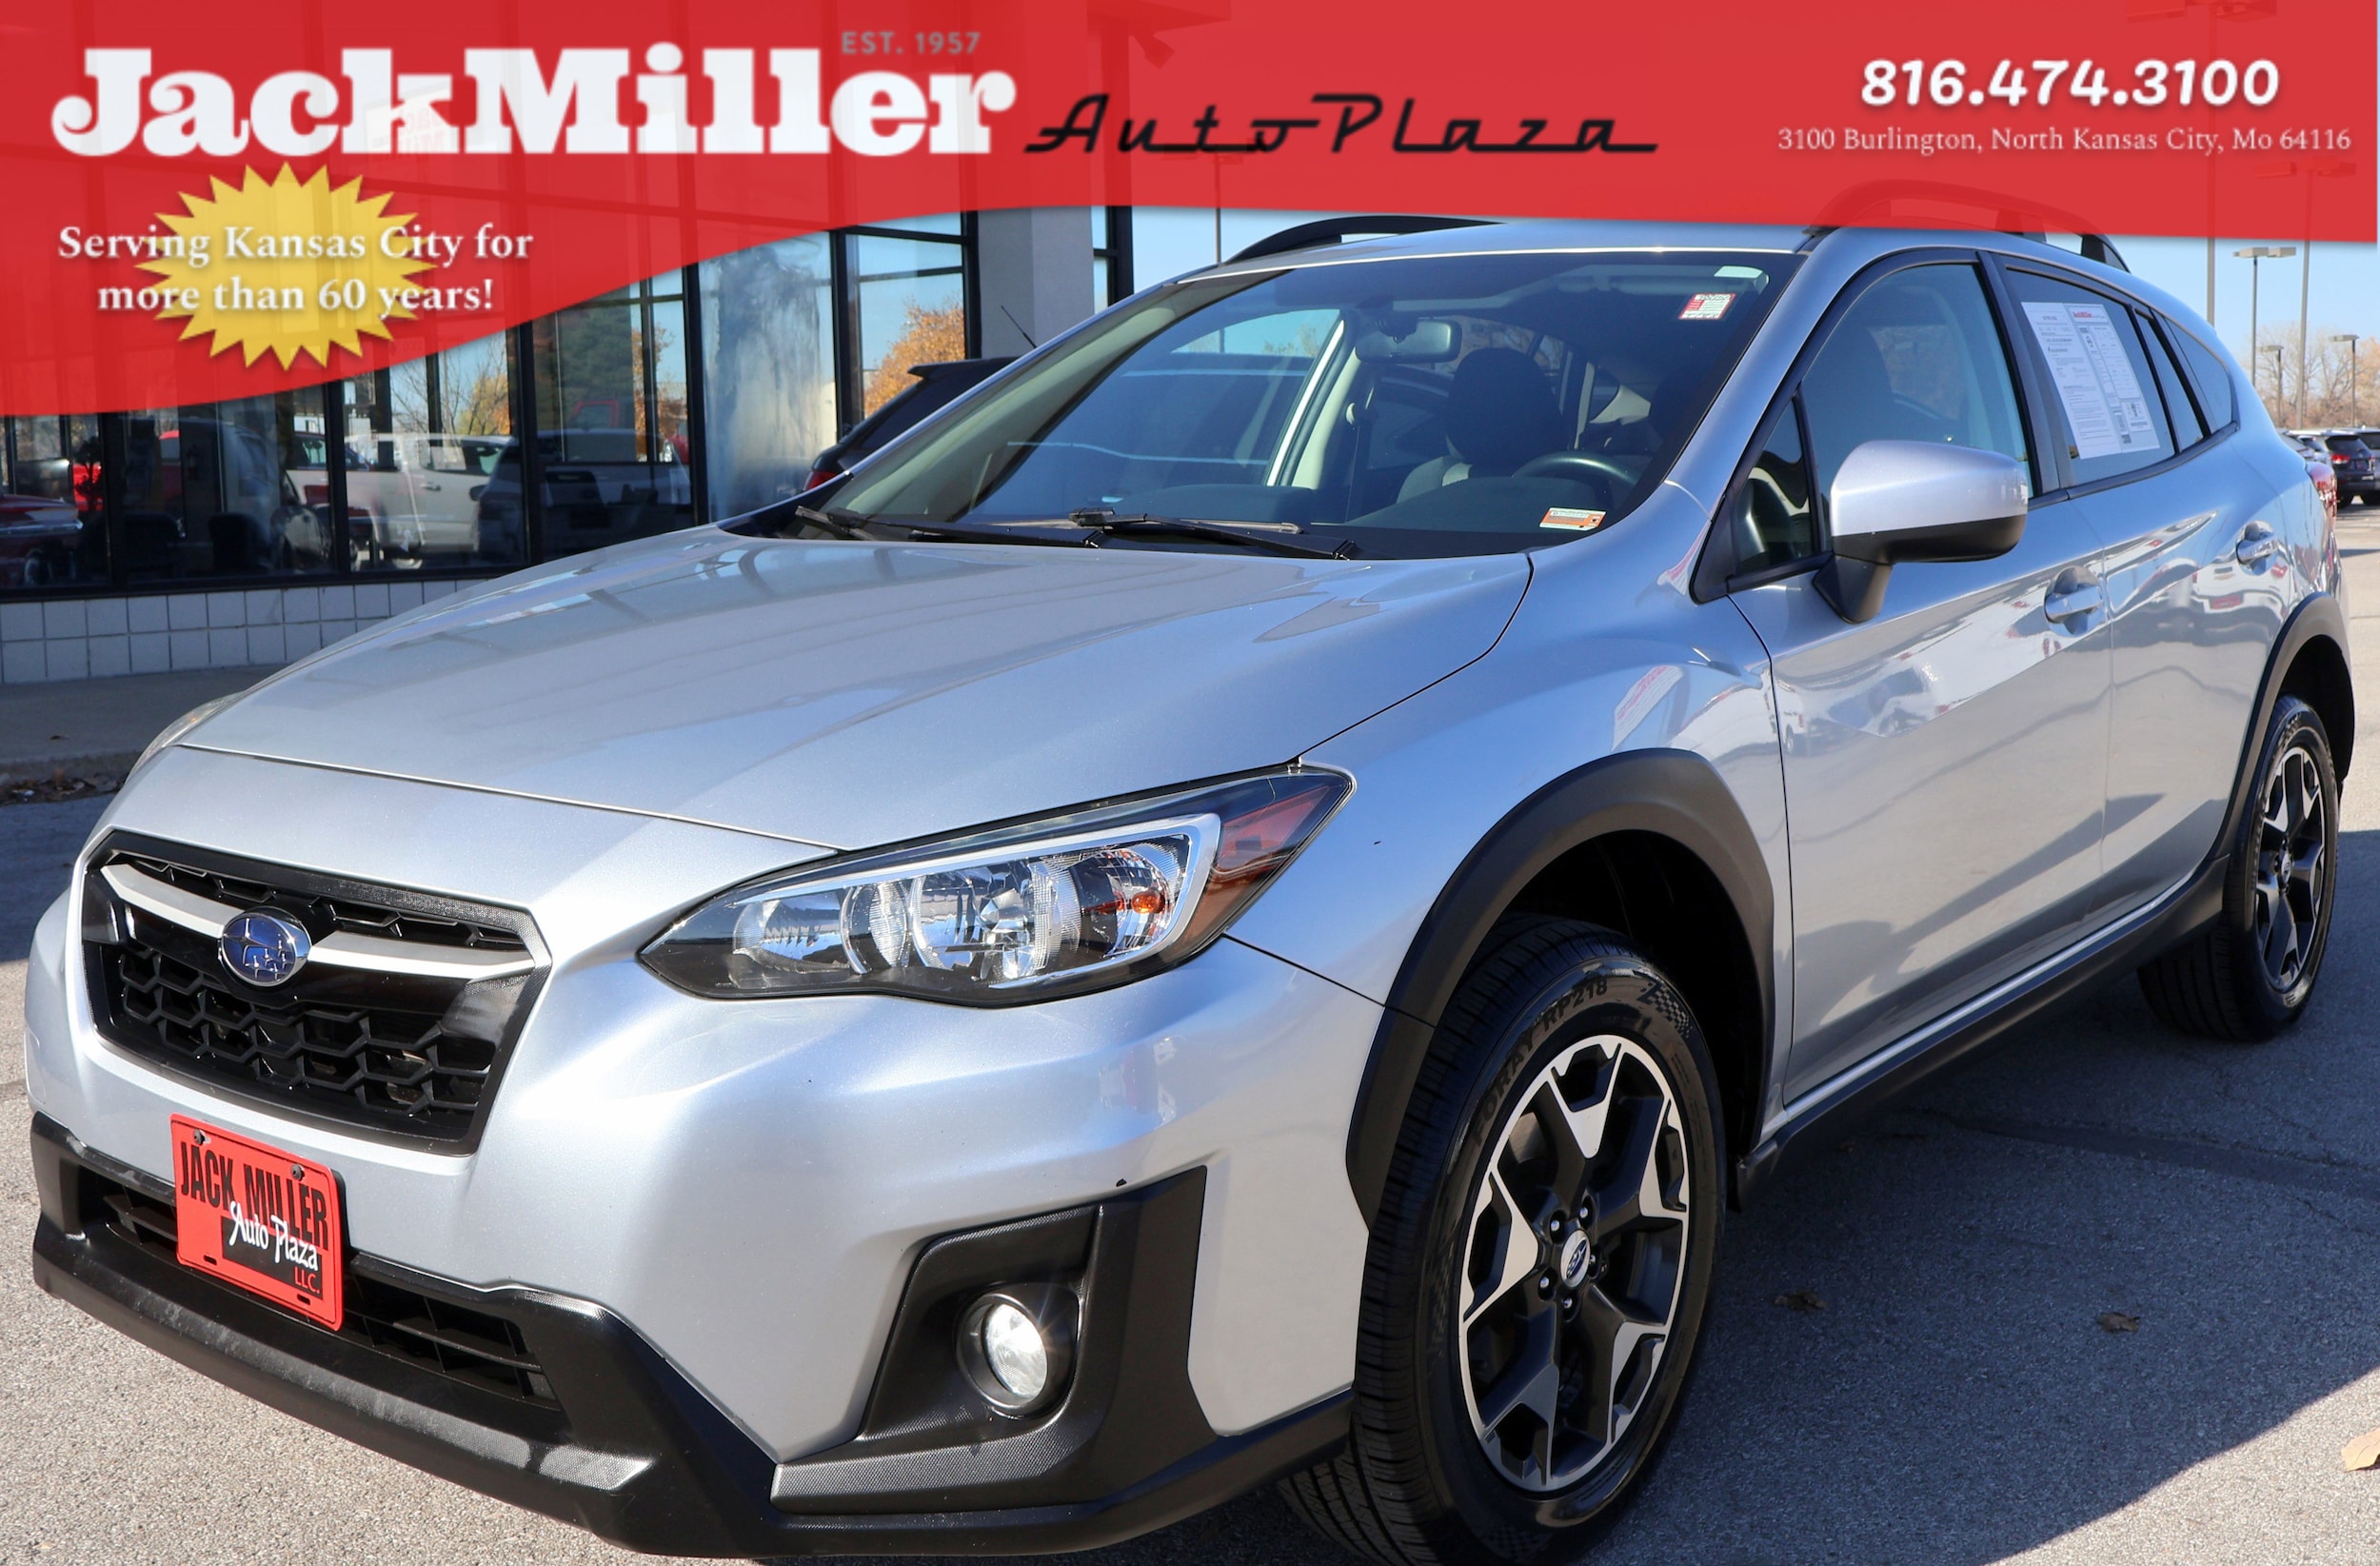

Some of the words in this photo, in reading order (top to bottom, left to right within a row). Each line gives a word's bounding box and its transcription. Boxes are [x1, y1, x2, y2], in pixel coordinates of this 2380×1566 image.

[180, 1140, 235, 1213] JACK
[243, 1162, 329, 1252] MILLER
[228, 1199, 269, 1250] Auto
[270, 1214, 319, 1272] Plaza
[293, 1266, 322, 1295] LLC.
